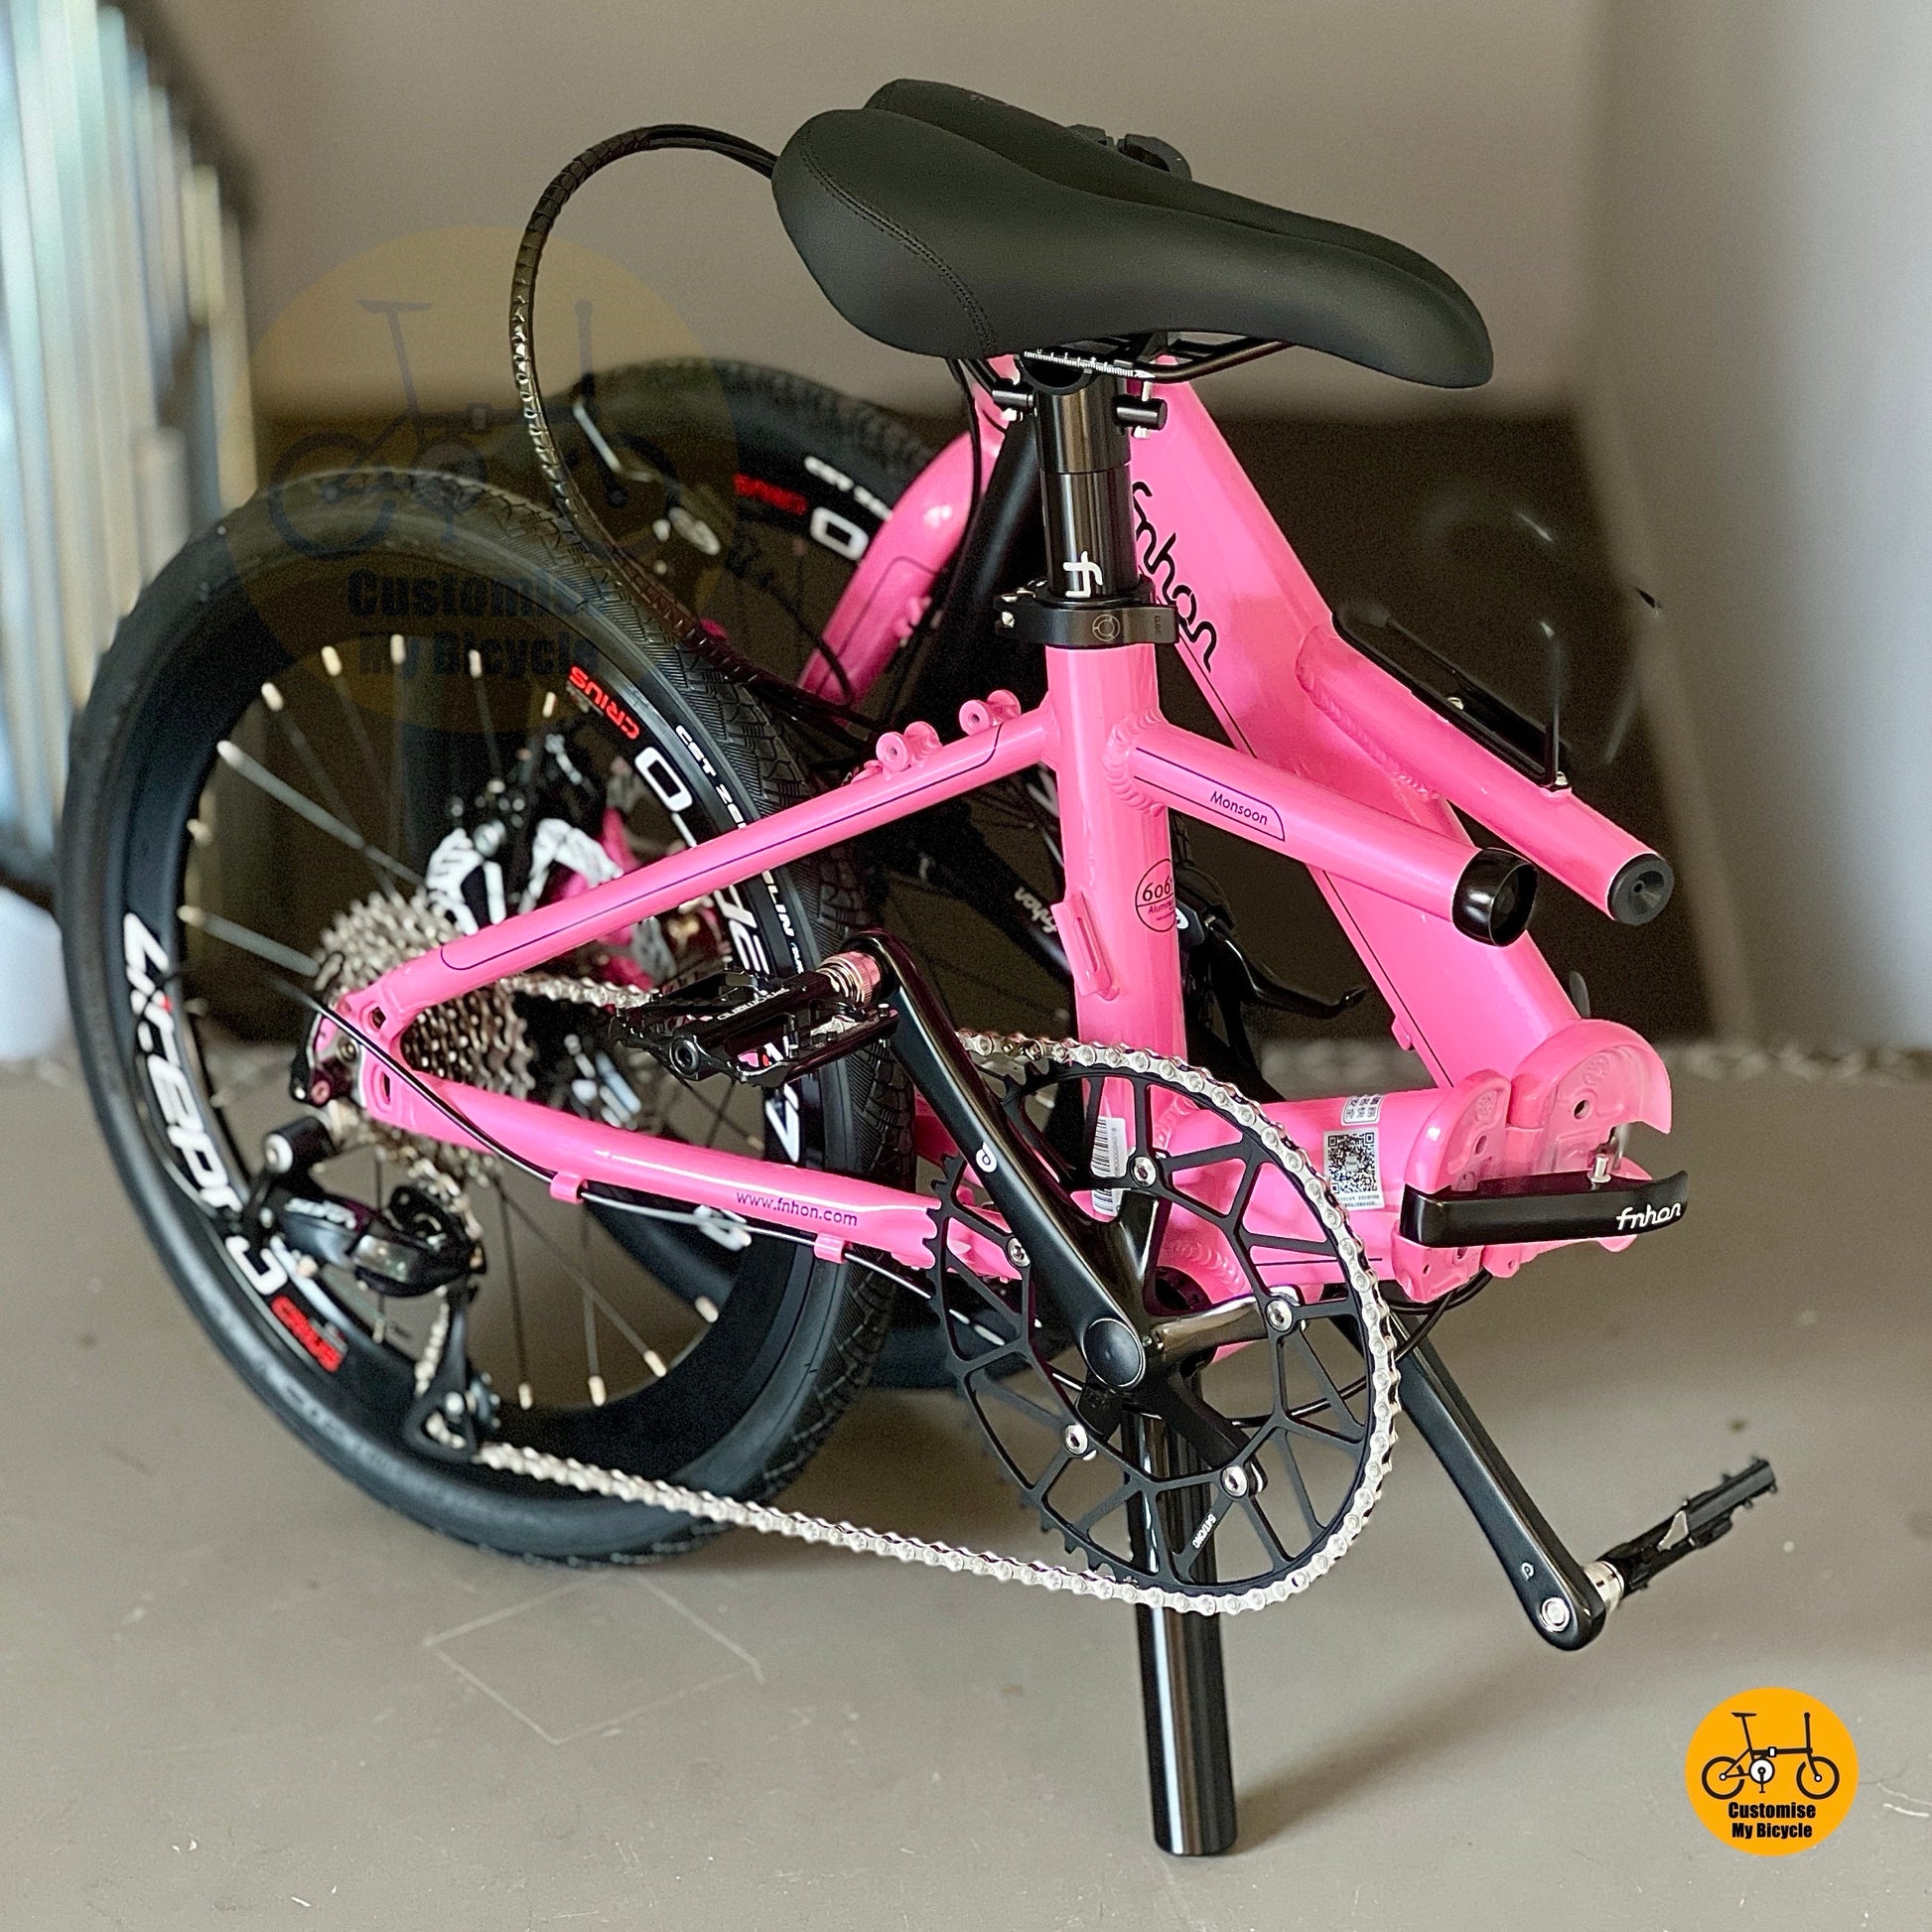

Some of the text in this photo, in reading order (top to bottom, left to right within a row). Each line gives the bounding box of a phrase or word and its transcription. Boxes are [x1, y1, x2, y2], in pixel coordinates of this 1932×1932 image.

[568, 665, 641, 741] CRIUS
[675, 725, 717, 777] CST
[1210, 790, 1268, 826] Monsoon
[737, 1191, 859, 1227] www.fnhon.com
[1615, 1202, 1681, 1231] fnhon
